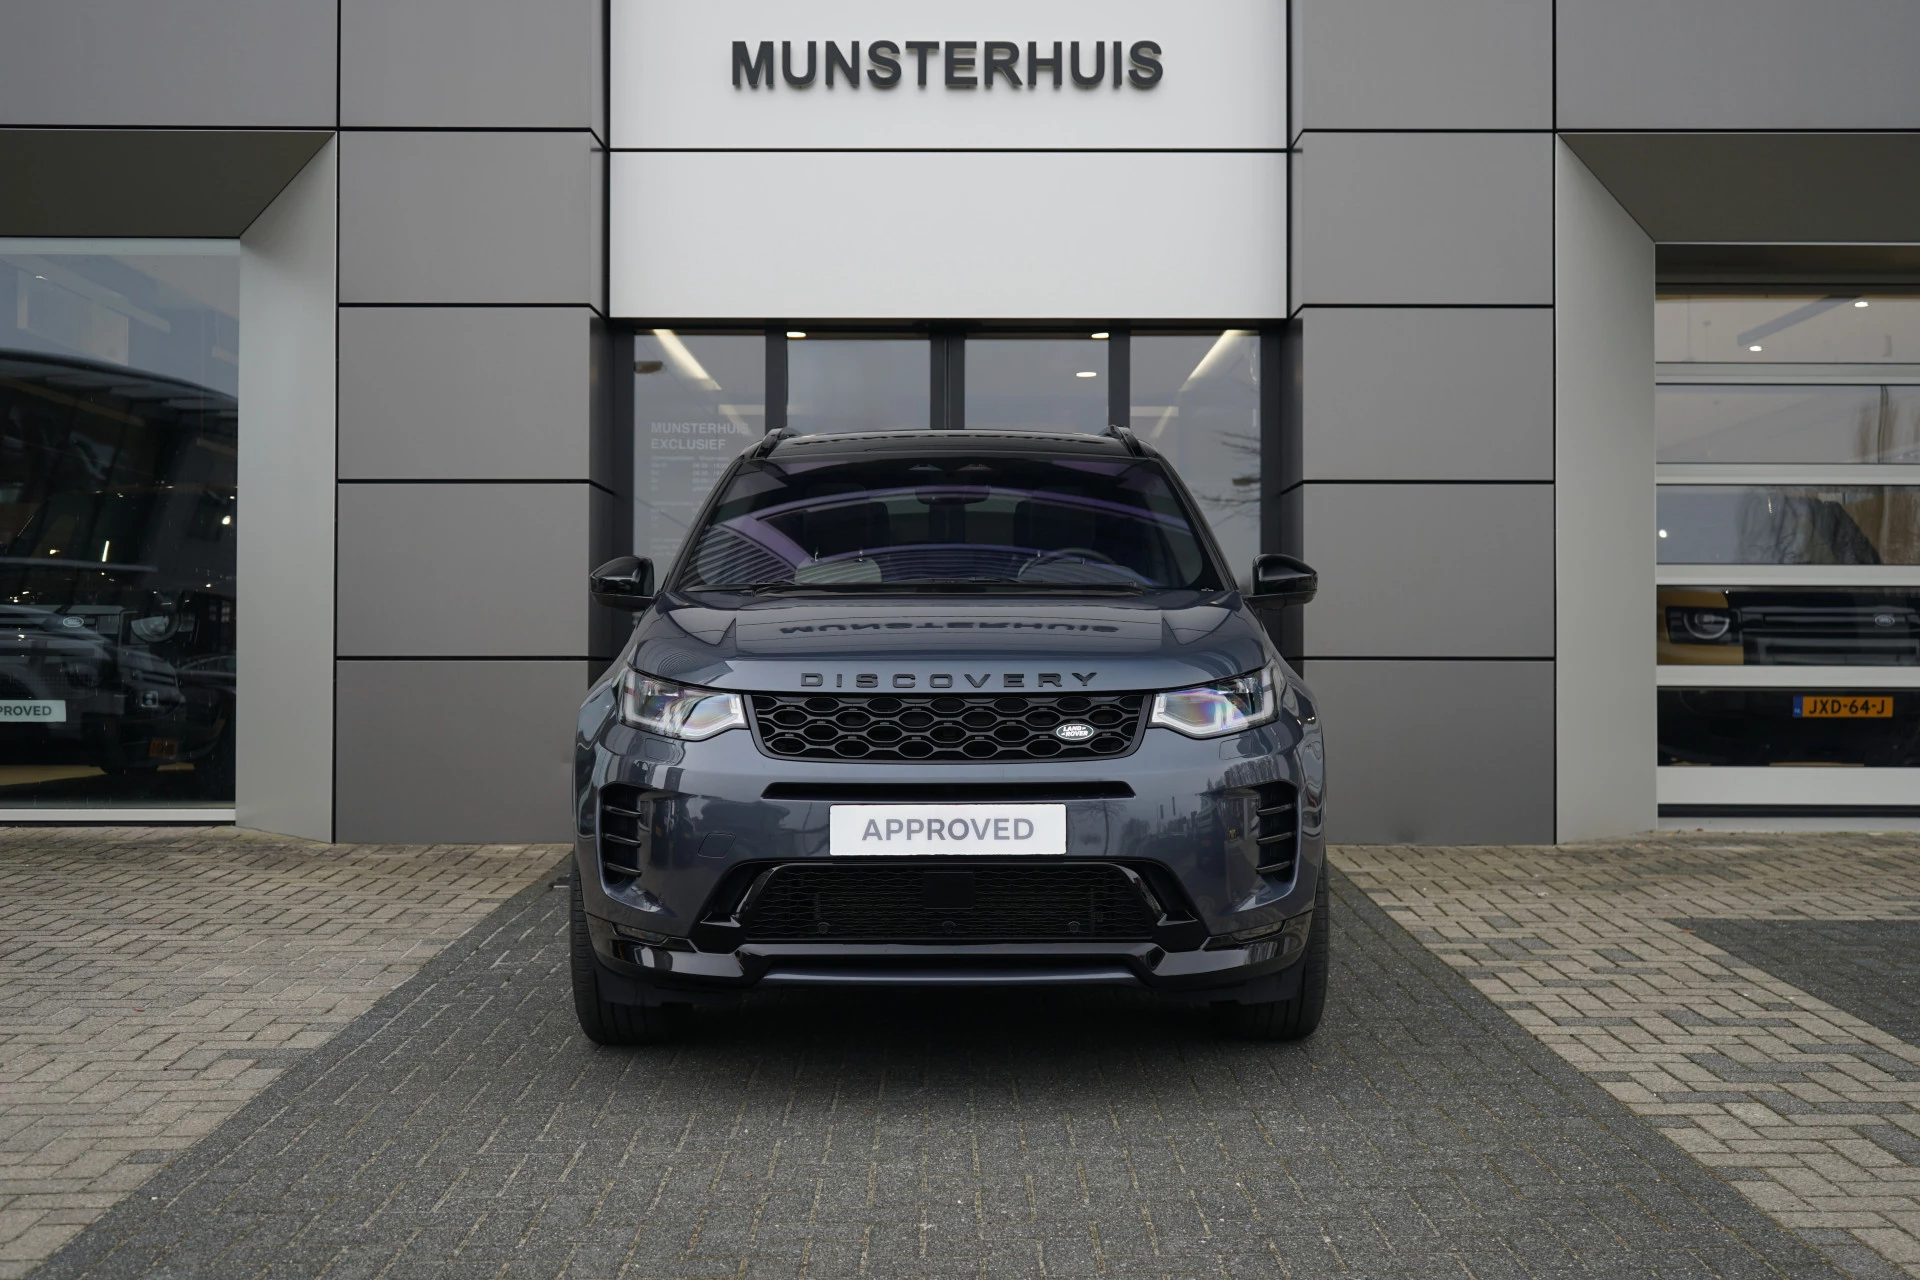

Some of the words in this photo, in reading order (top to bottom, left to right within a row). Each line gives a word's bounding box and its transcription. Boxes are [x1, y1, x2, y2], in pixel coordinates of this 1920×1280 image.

[731, 40, 1164, 88] MUNSTERHUIS
[651, 422, 749, 434] MUNSTERHUIS
[651, 438, 726, 450] EXCLUSIEF
[800, 672, 1098, 688] DISCOVERY
[1809, 700, 1885, 714] JXD-64-J
[862, 818, 1034, 841] APPROVED
